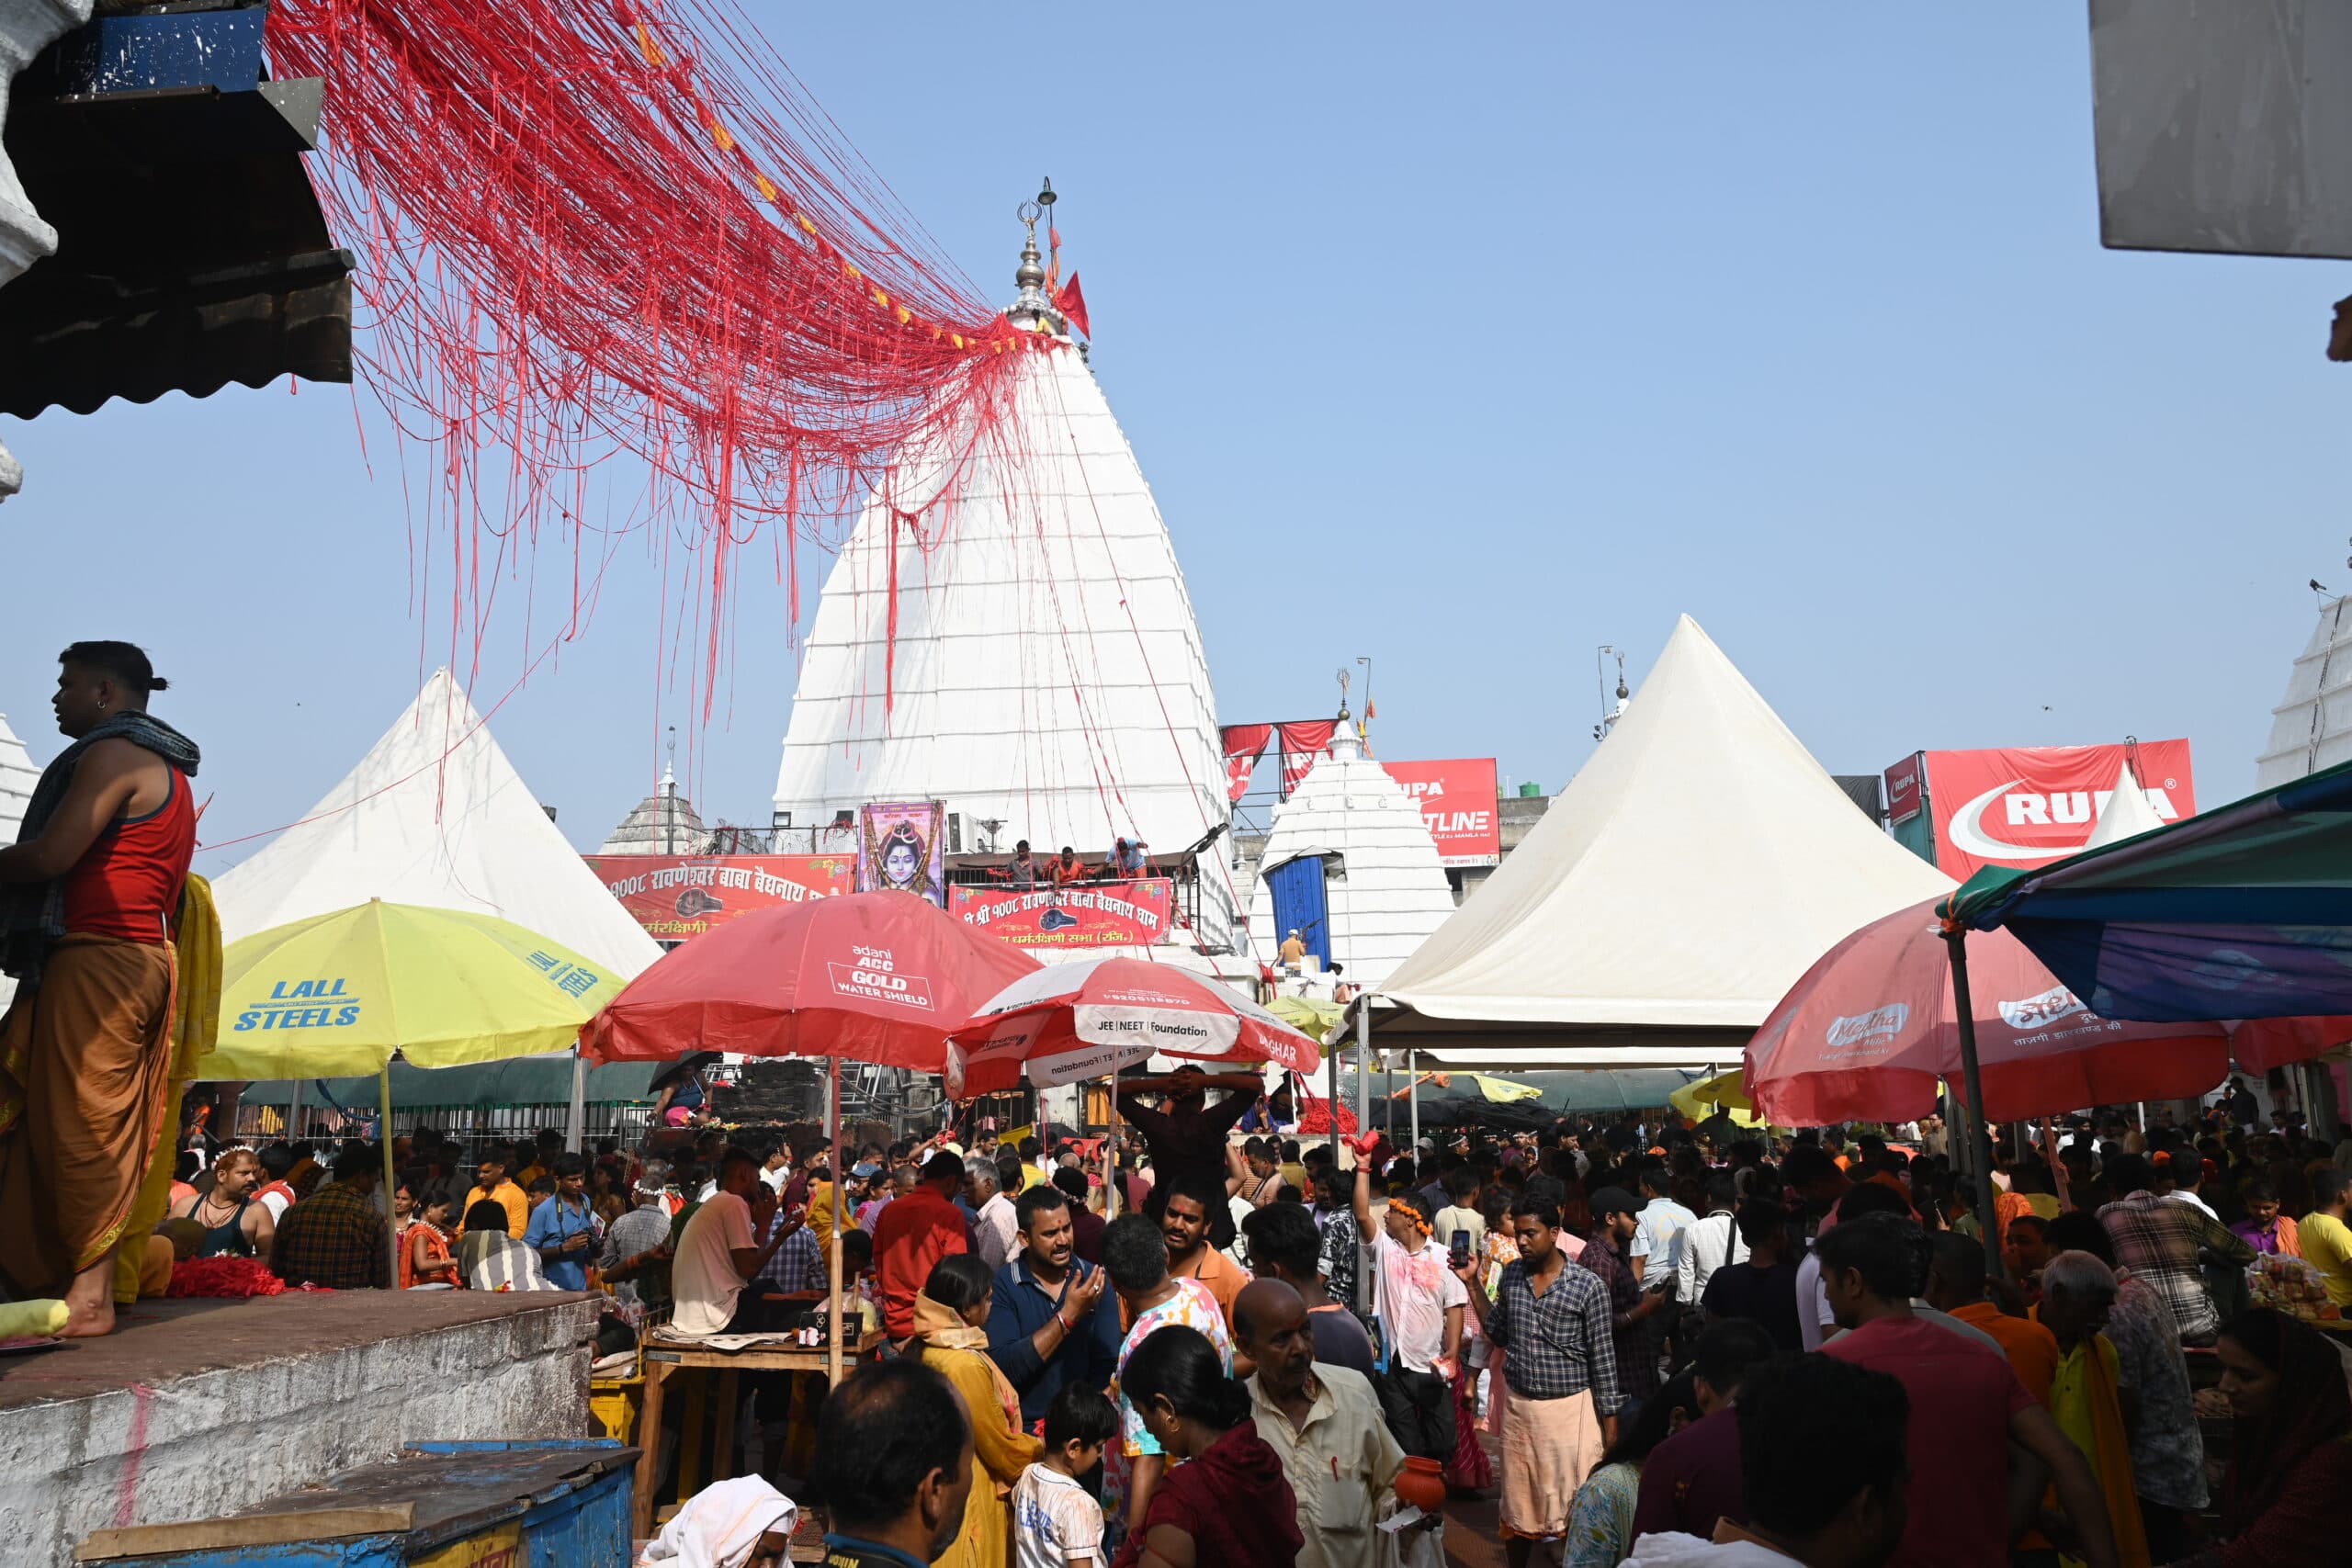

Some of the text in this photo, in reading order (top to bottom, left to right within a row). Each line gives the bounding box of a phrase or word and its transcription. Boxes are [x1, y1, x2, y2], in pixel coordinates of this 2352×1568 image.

[1894, 773, 1916, 792] RUPA
[1421, 811, 1490, 831] TLINE
[718, 867, 752, 889] बाबा
[977, 905, 990, 926] श्री
[992, 898, 1019, 919] १००८
[1070, 891, 1095, 908] बाबा
[526, 950, 560, 971] LALL
[853, 945, 892, 960] adani
[857, 957, 894, 972] ACC
[270, 978, 347, 999] LALL
[558, 967, 598, 998] STEELS
[851, 970, 908, 991] GOLD
[837, 982, 929, 1006] WATER SHIELD
[233, 1006, 361, 1031] STEELS
[1098, 1021, 1208, 1037] JEE NEET Foundation
[1835, 1010, 1899, 1040] Medha
[2107, 1021, 2121, 1031] की
